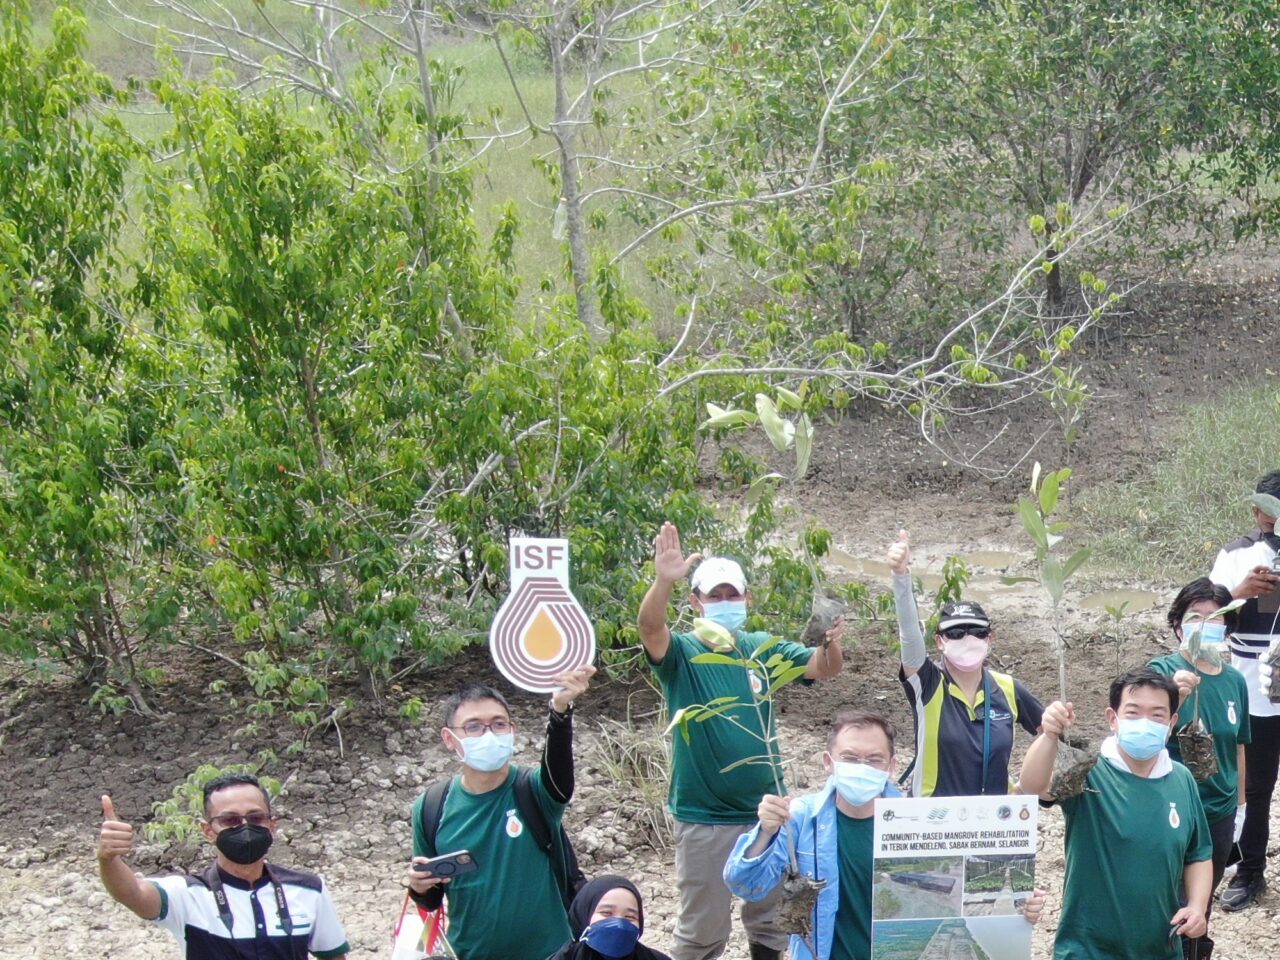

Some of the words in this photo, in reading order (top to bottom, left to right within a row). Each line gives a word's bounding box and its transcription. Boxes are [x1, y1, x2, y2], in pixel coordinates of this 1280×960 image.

[514, 545, 564, 570] ISF
[881, 832, 943, 842] COMMUNITY-BASED
[944, 831, 978, 839] MANGROVE
[980, 830, 1029, 839] REHABILITATION
[889, 843, 909, 851] TEBUK
[949, 841, 969, 849] SABAK
[998, 839, 1029, 848] SELANGOR
